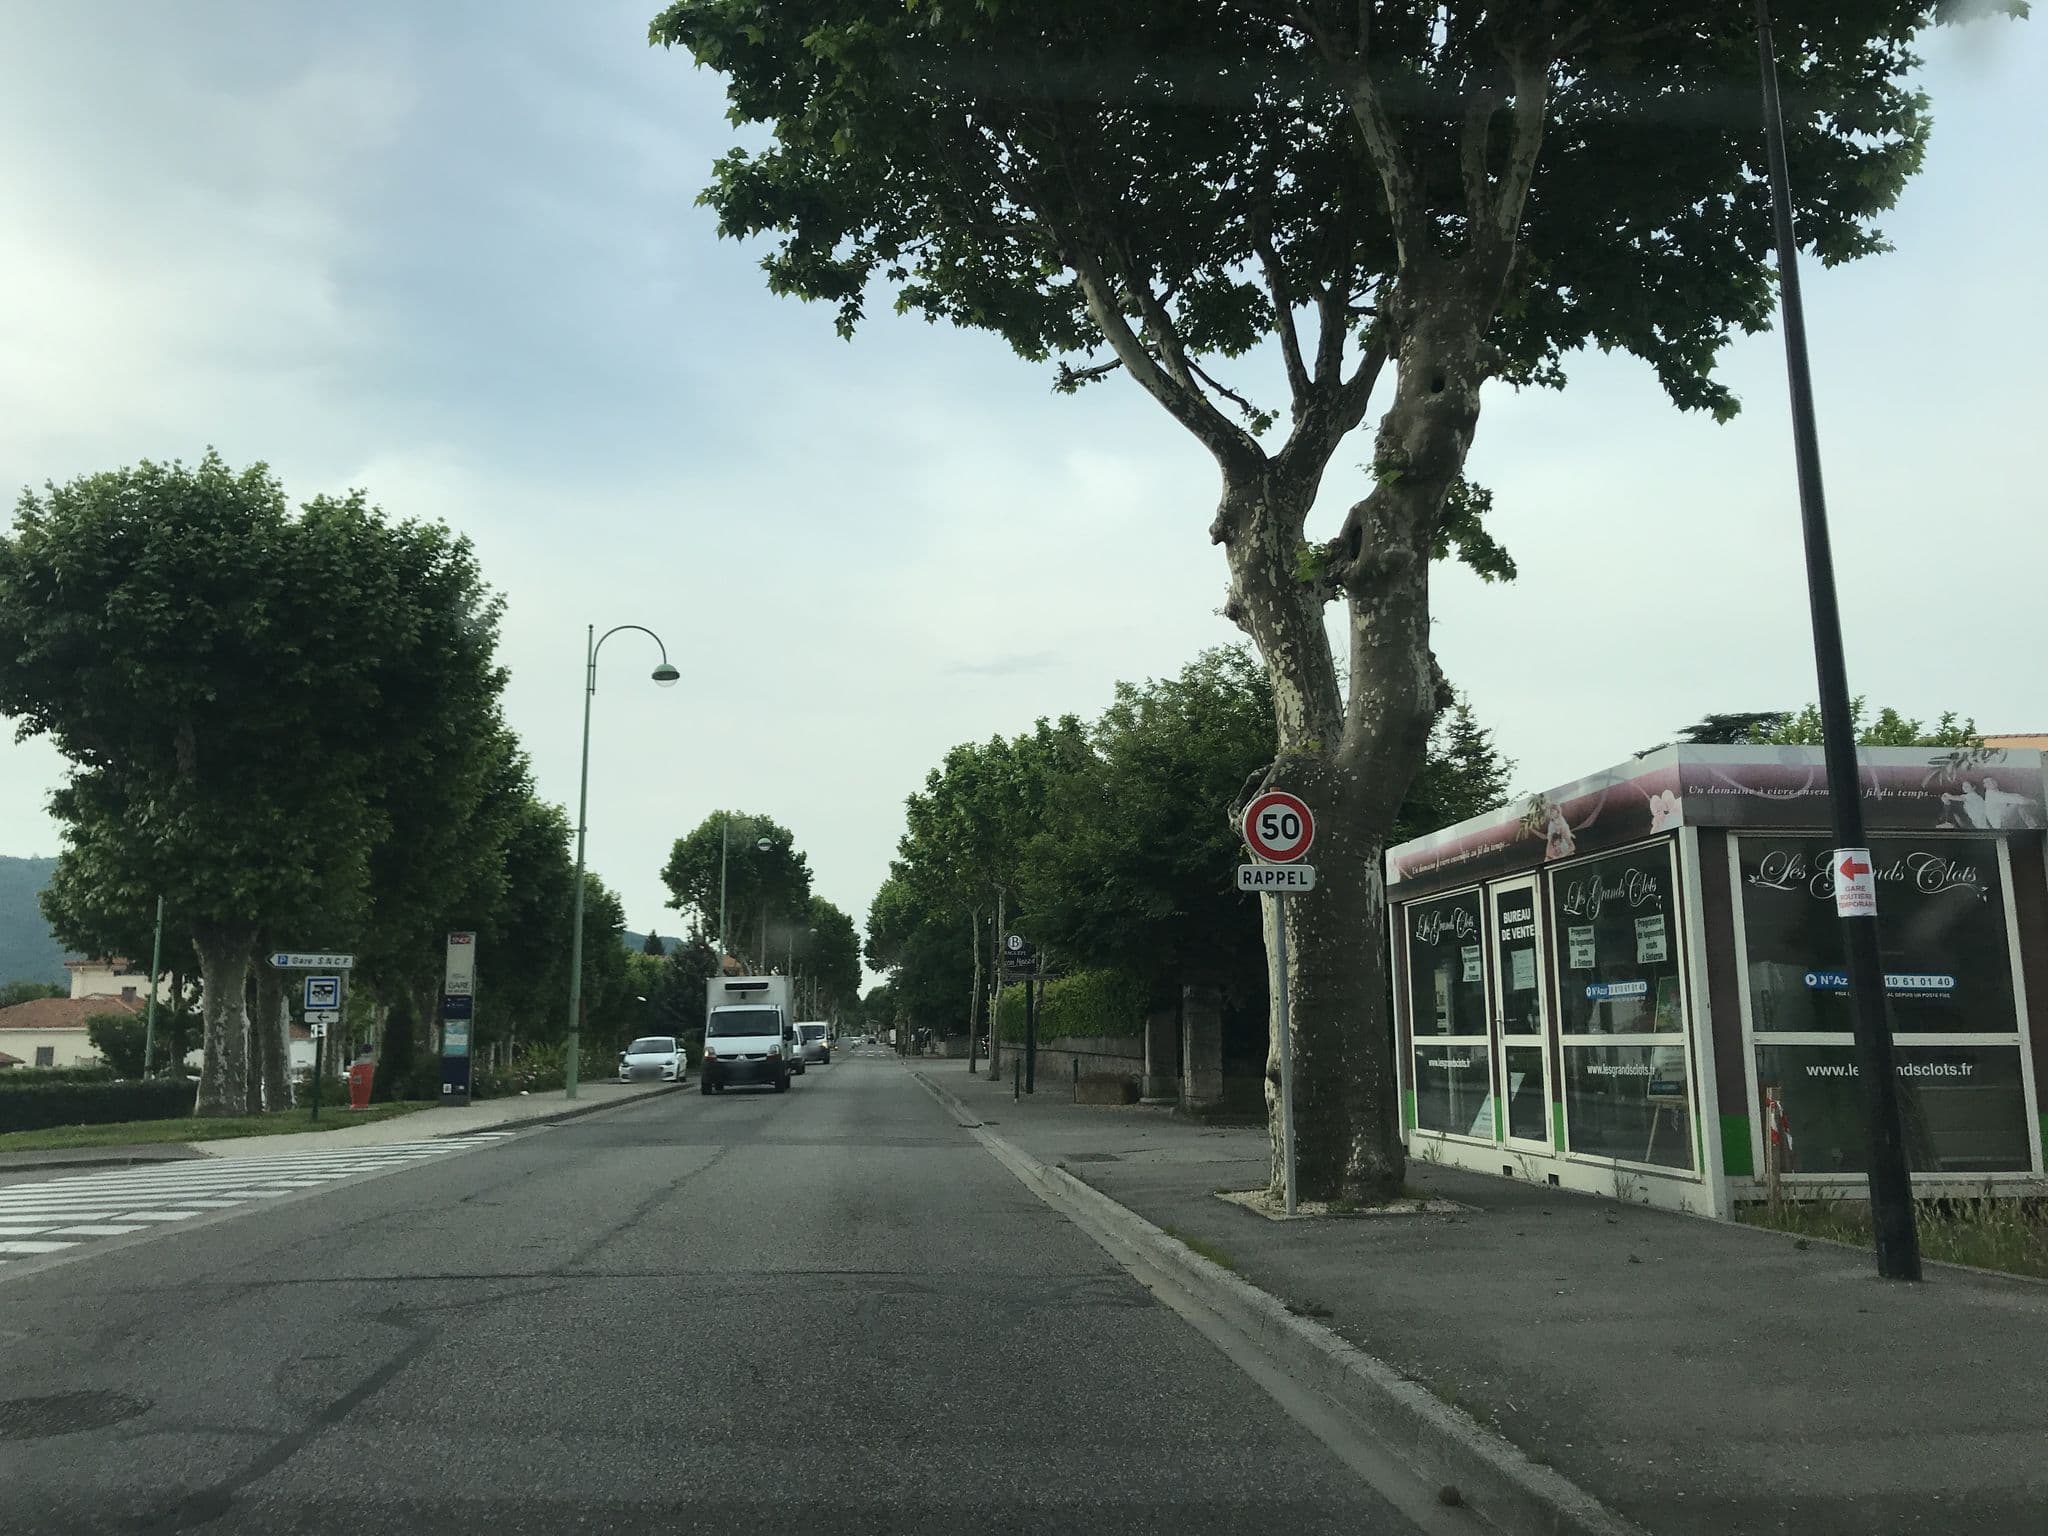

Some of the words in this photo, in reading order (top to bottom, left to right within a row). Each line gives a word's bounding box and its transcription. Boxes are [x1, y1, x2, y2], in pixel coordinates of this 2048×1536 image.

[1688, 785, 1704, 794] Un
[1707, 785, 1754, 795] domaine
[1767, 787, 1794, 796] vivre
[1797, 788, 1829, 796] ensem
[1880, 787, 1894, 797] du
[1261, 813, 1300, 841] 50
[1243, 870, 1308, 885] RAPPEL
[1757, 851, 1806, 890] Les
[1906, 852, 1980, 894] Clots
[1564, 881, 1586, 915] Les
[1587, 874, 1625, 921] Grands
[1625, 868, 1658, 907] Clots
[1503, 908, 1531, 924] BUREAU
[1501, 929, 1511, 941] DE
[1511, 924, 1535, 940] VENTE
[291, 956, 313, 964] Gare
[1903, 977, 1915, 986] 61
[1919, 977, 1932, 986] 01
[1937, 977, 1950, 986] 40
[1587, 1063, 1656, 1078] www.lesgrandsclots.fr
